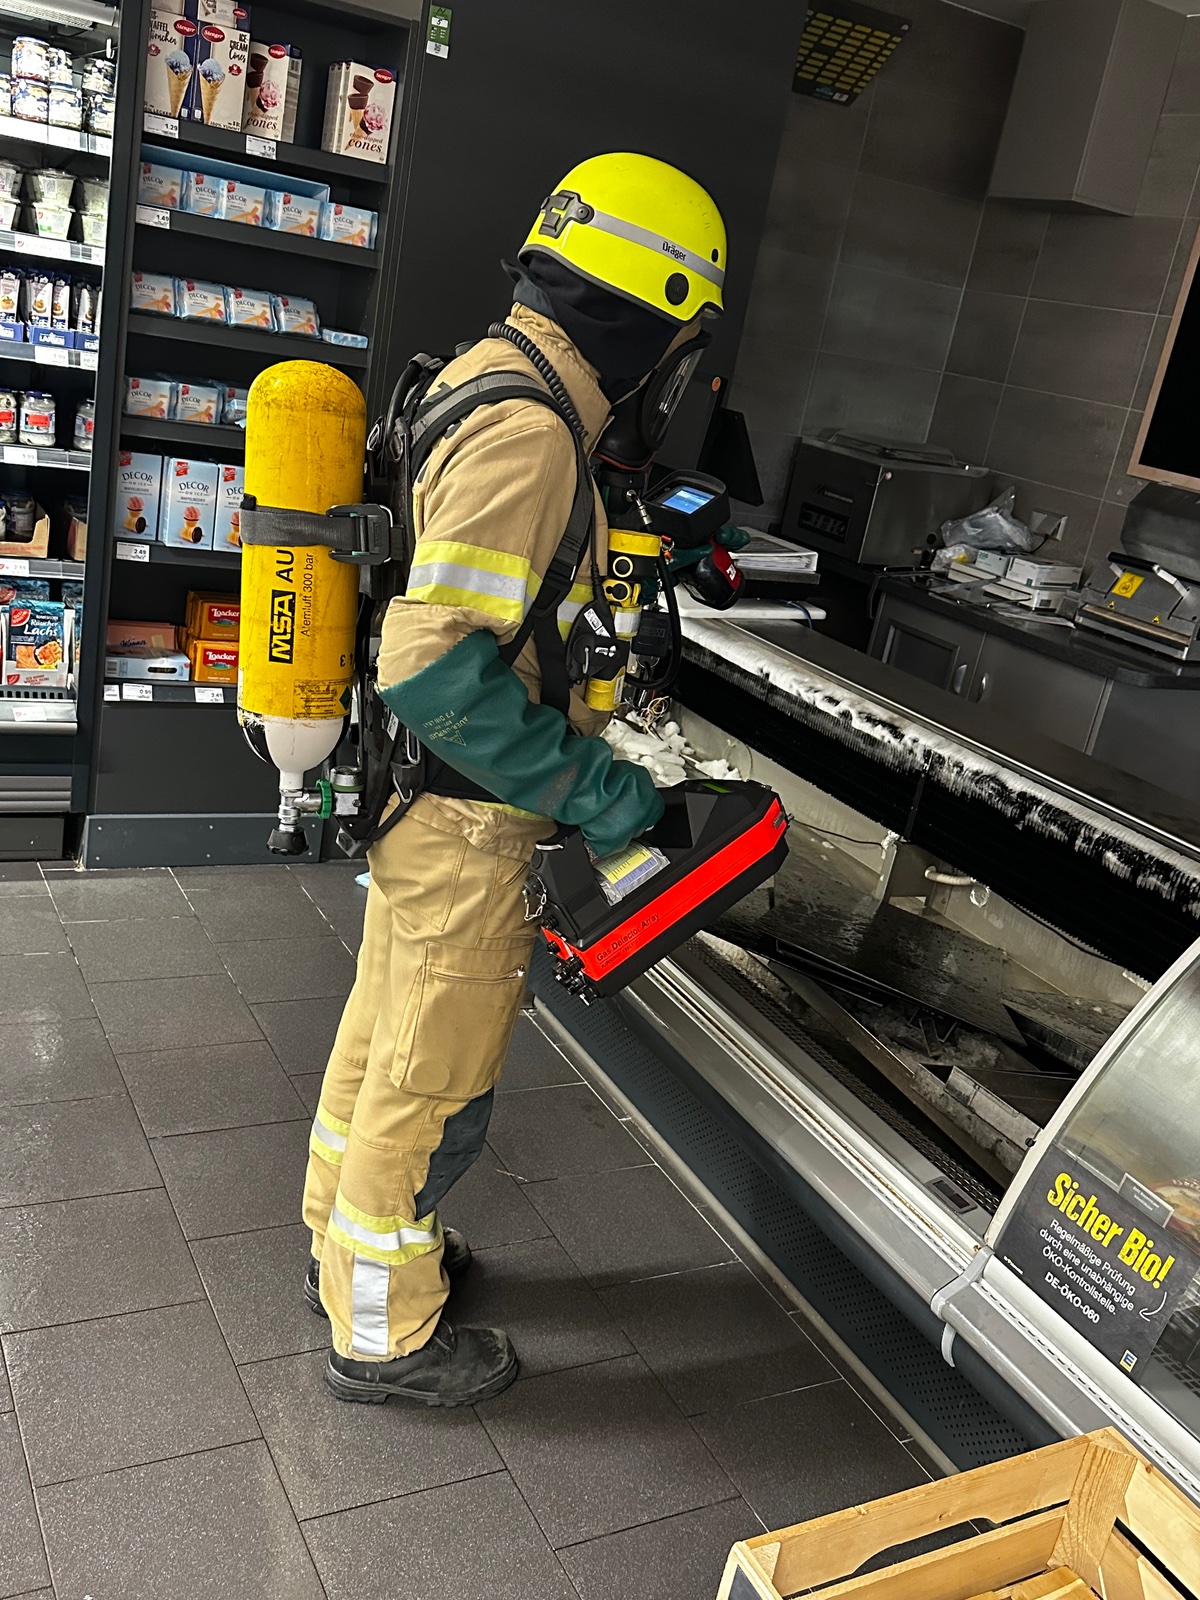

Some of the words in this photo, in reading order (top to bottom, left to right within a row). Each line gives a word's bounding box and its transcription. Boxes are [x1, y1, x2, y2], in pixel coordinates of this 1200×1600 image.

[246, 117, 277, 130] cones
[348, 138, 382, 153] cones
[195, 186, 216, 196] DECOR
[227, 194, 247, 204] DECOR
[282, 206, 302, 215] DECOR
[662, 240, 686, 261] Dräger
[122, 472, 153, 483] DECOR
[179, 481, 209, 493] DECOR
[226, 487, 244, 496] DEC
[276, 545, 294, 583] AU
[304, 553, 313, 570] bar
[303, 573, 313, 592] 300
[211, 608, 239, 617] Loacker
[24, 624, 58, 636] Lachs
[271, 594, 293, 660] MSA
[206, 651, 236, 660] Loacker
[597, 948, 611, 961] Gas
[611, 928, 640, 950] Detector
[641, 914, 659, 929] Array
[1047, 1172, 1124, 1247] Sicher
[1117, 1228, 1175, 1289] Bio!
[1050, 1219, 1102, 1266] Regelmäßige
[1102, 1262, 1136, 1296] Prüfung
[1040, 1229, 1063, 1251] durch
[1063, 1248, 1080, 1266] eine
[1081, 1263, 1134, 1310] unabhängige
[1043, 1245, 1116, 1315] ÖKO-Kontrollstelle.
[1045, 1272, 1100, 1324] DE-ÖKO-060
